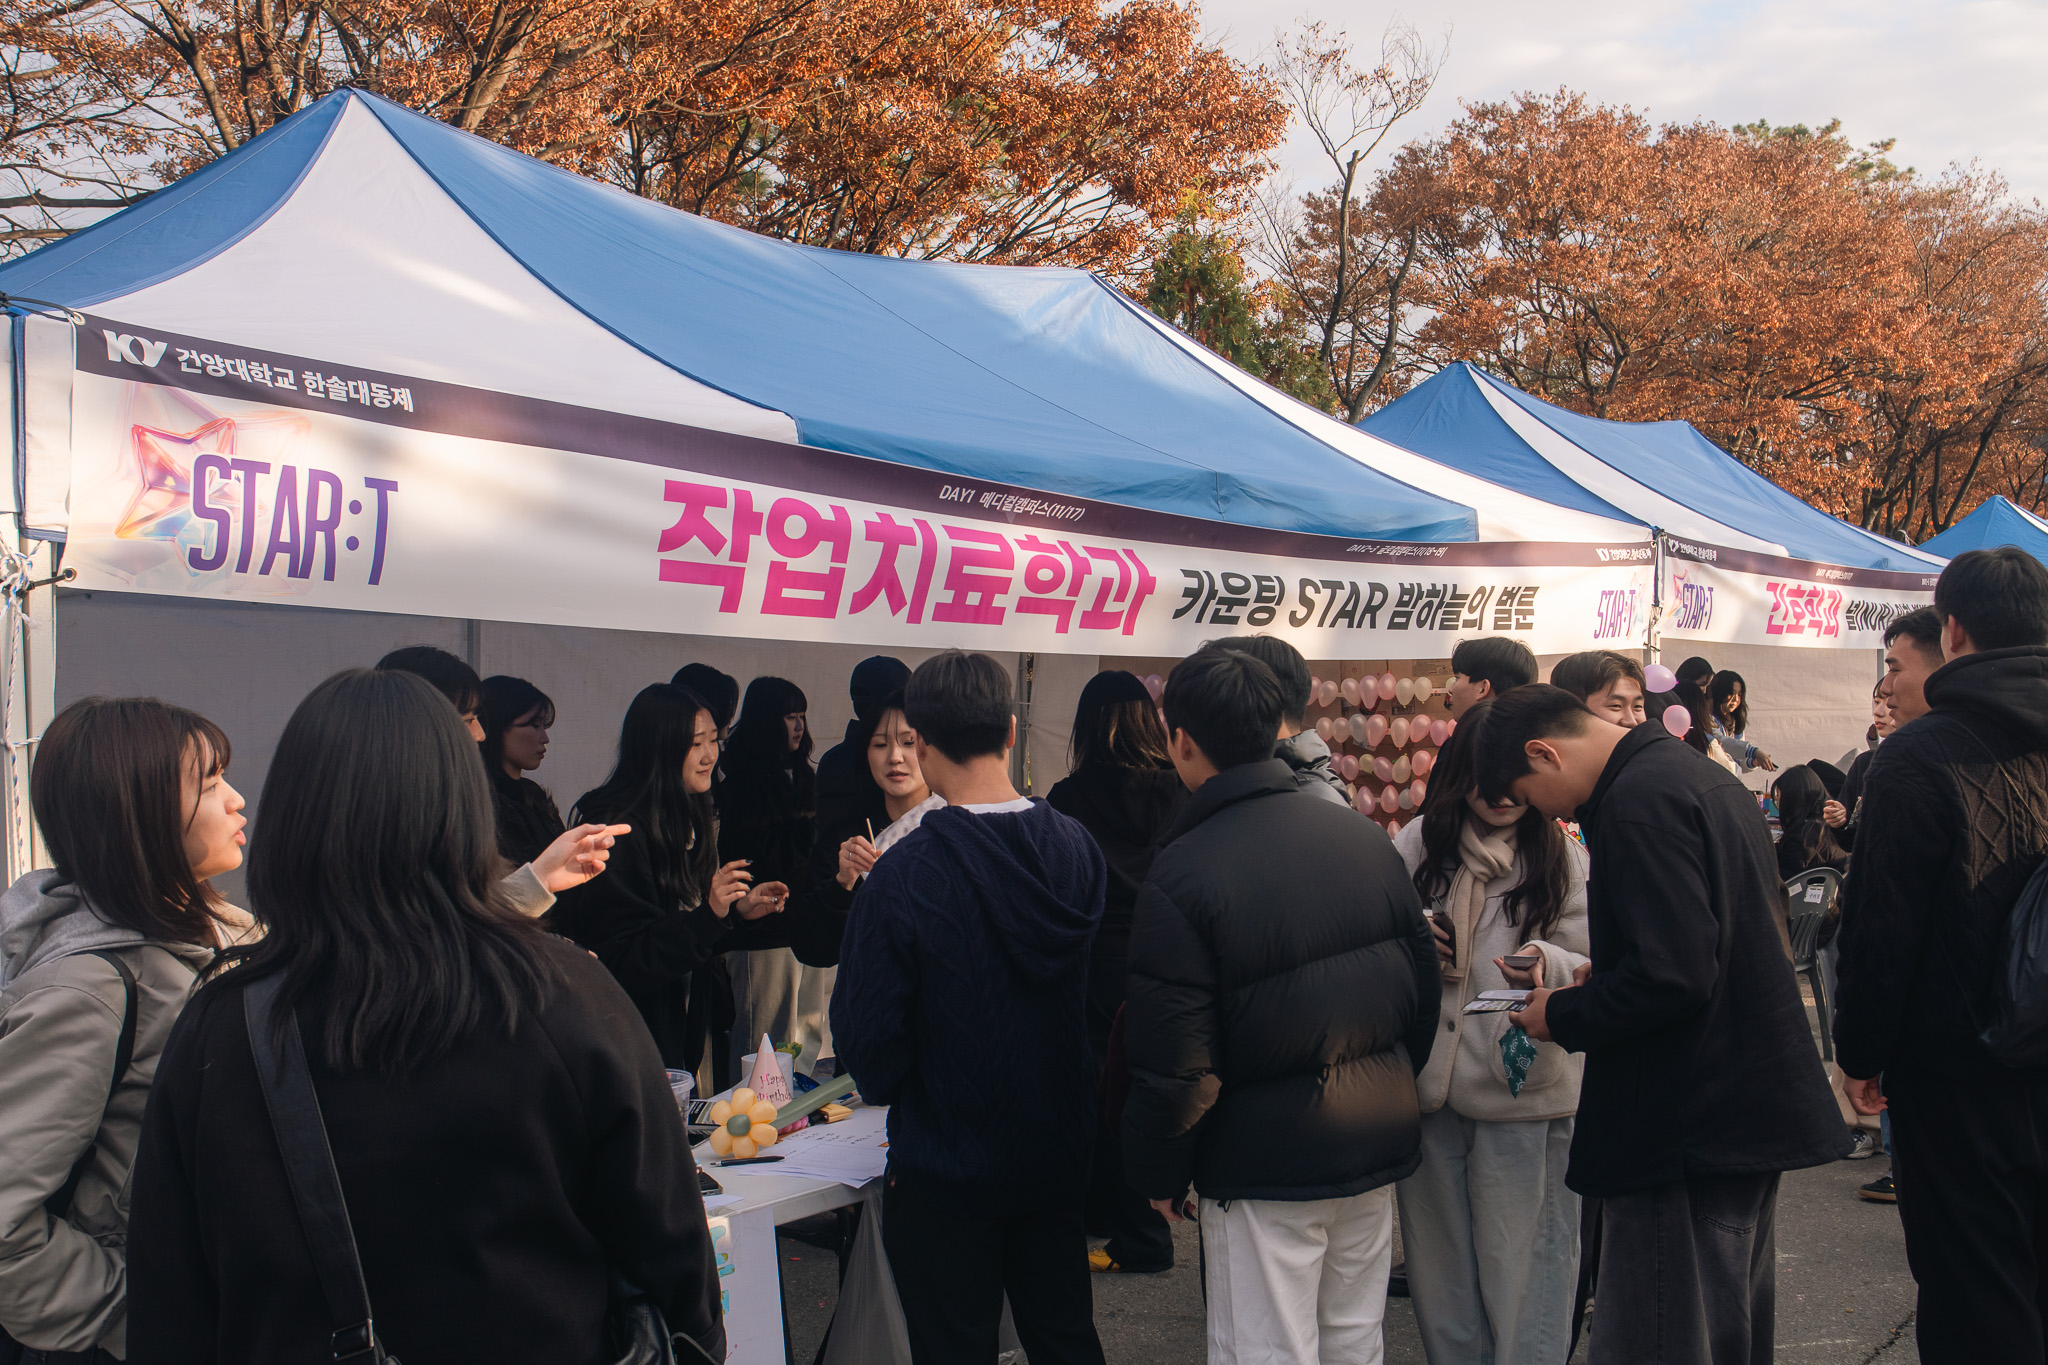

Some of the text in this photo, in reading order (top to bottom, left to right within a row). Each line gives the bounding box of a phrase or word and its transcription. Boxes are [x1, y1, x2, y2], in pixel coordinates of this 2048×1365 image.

[175, 347, 298, 390] 건양대학교
[301, 370, 414, 412] 한솔대동제
[188, 454, 398, 586] STAR:T
[939, 484, 1085, 522] DAY1 메디컬캠퍼스(11/17)
[657, 478, 1540, 636] 작업치료학과 카운팅 STAR 밤하늘의 벌룬
[1593, 589, 1636, 639] STAR:T
[1677, 583, 1714, 630] STAR:T
[1766, 581, 1843, 638] 간호학과
